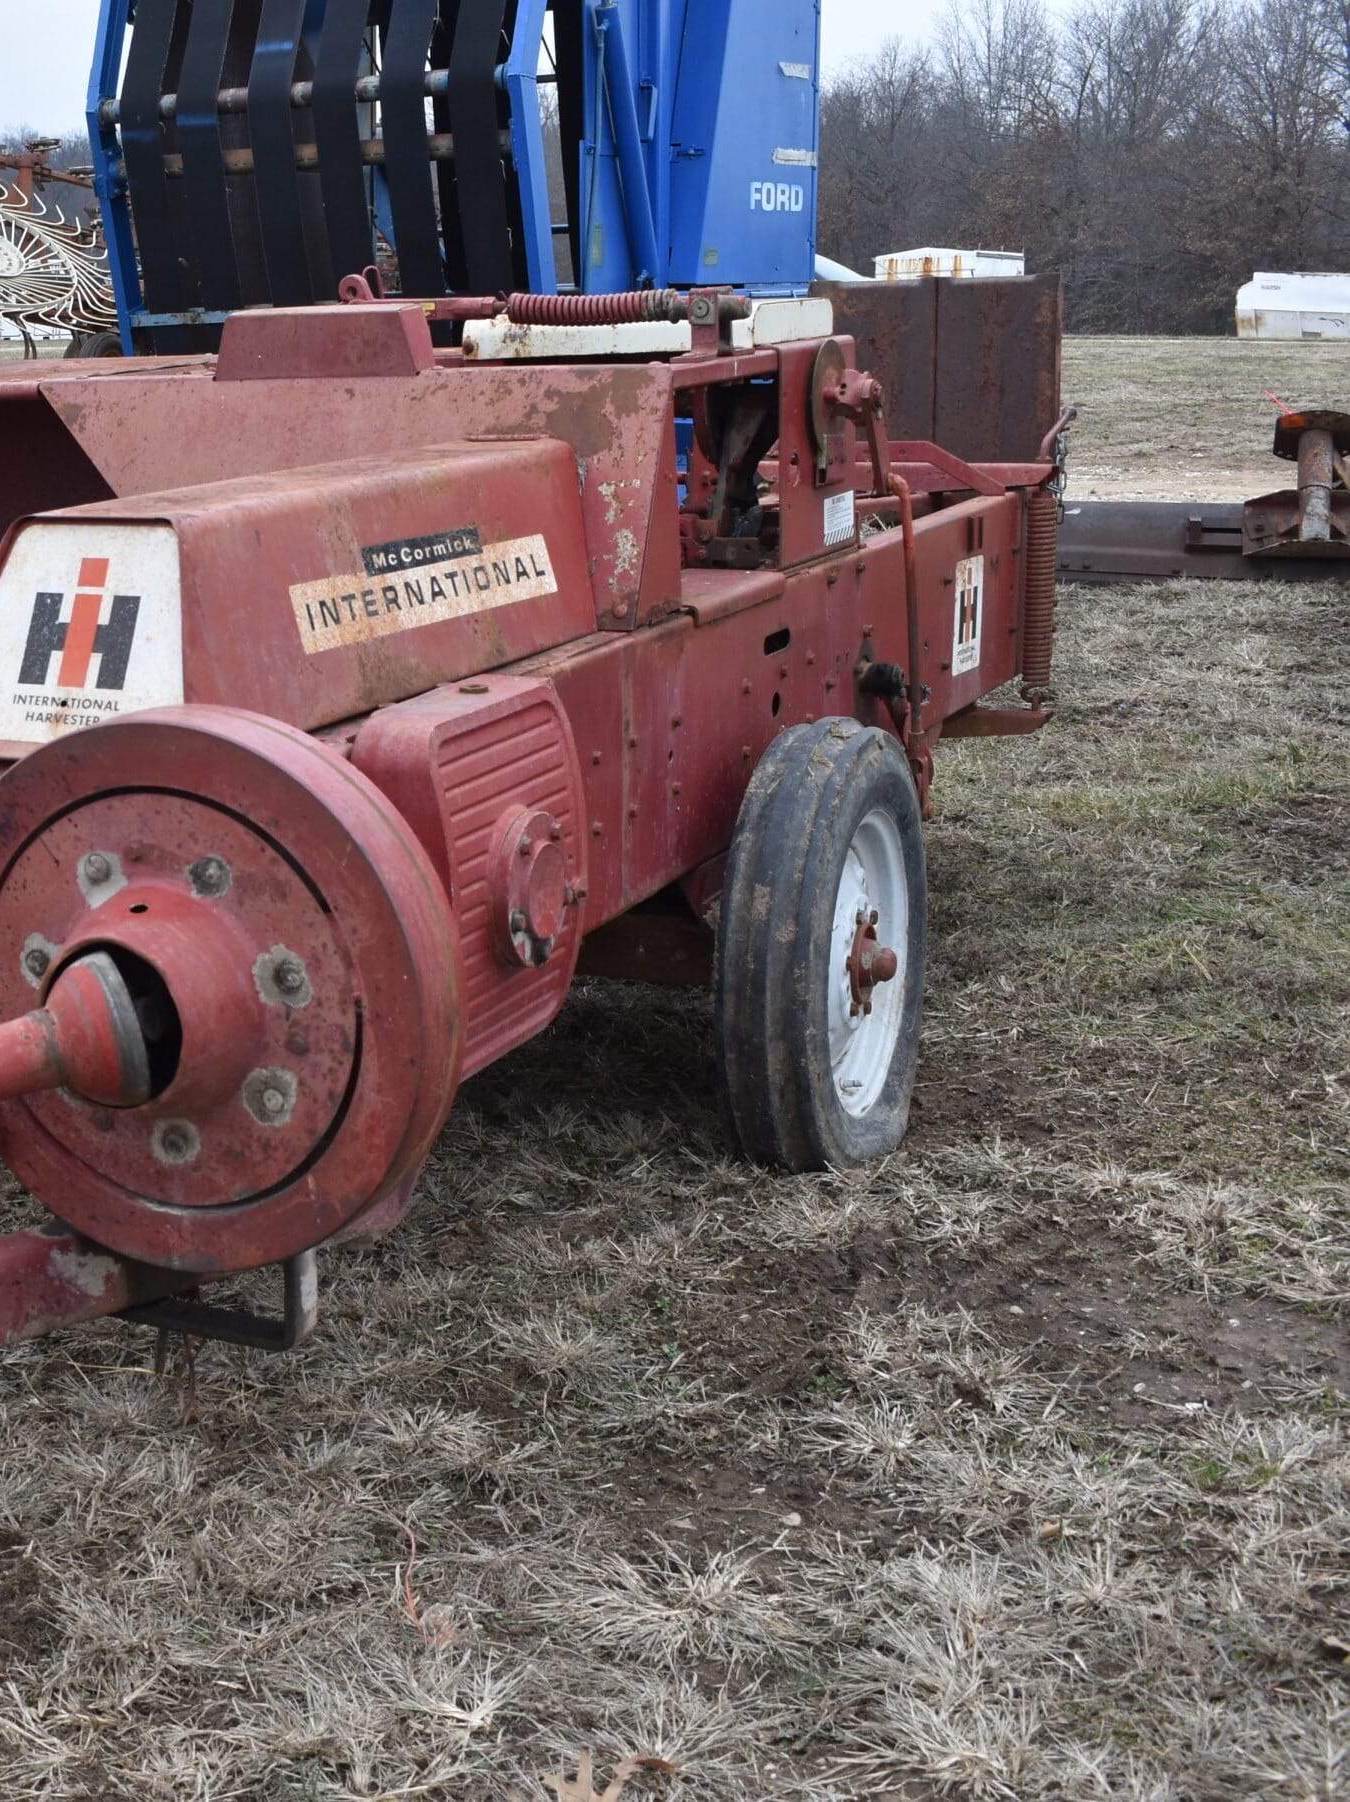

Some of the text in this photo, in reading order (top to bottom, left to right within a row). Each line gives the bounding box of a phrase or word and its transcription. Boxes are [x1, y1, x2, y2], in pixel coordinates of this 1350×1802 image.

[749, 181, 804, 212] FORD
[371, 535, 476, 570] McCormick
[305, 552, 547, 632] INTERNATIONAL
